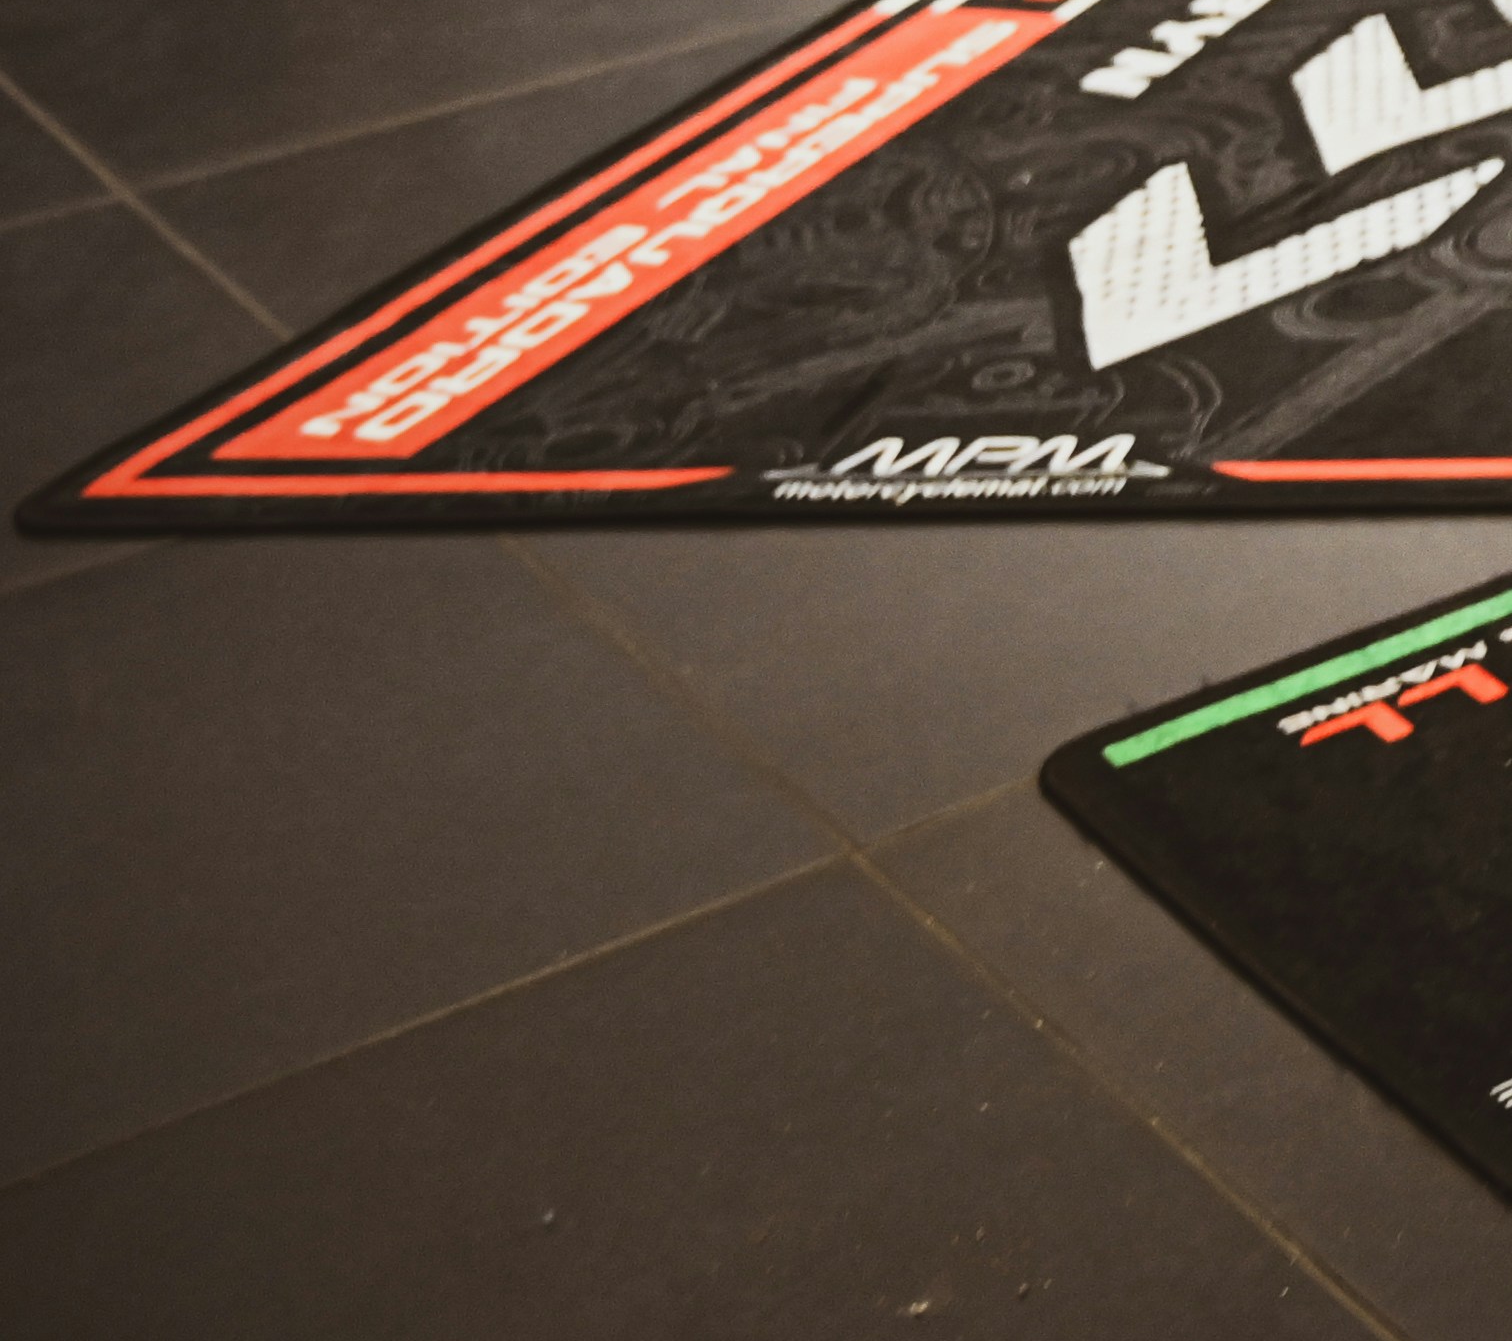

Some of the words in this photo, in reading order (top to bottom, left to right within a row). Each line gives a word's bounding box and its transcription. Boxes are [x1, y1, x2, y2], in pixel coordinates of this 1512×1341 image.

[354, 20, 1018, 441] SUPERQUADRO
[829, 434, 1136, 477] MPM
[1276, 640, 1488, 736] MARINE
